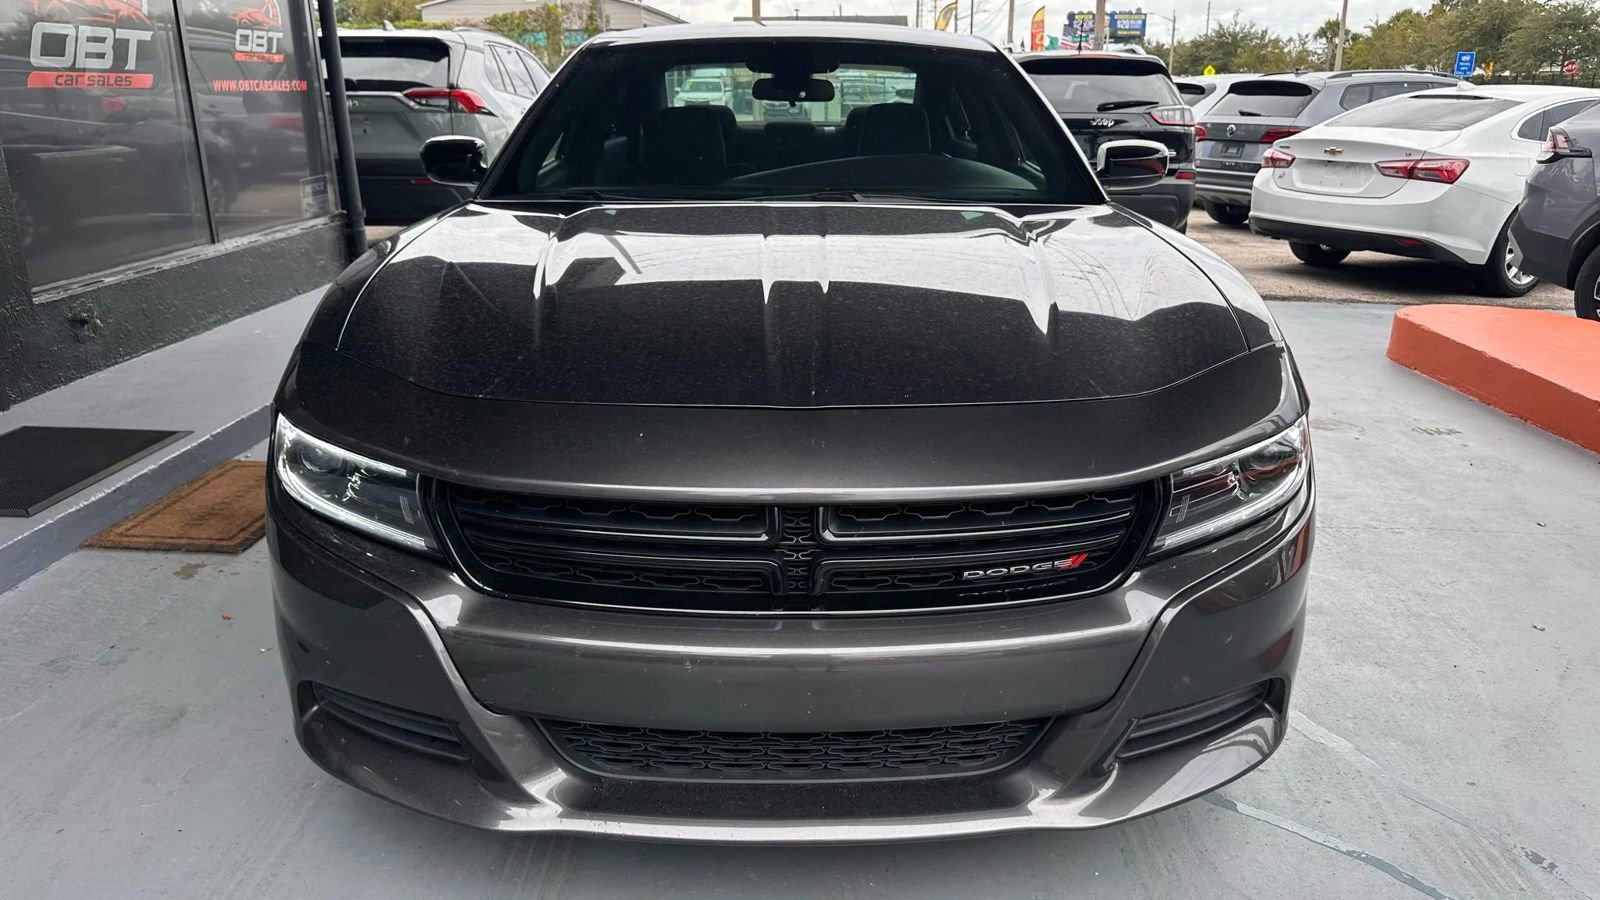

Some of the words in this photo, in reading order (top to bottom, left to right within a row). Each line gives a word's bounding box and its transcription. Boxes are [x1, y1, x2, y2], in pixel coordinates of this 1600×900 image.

[29, 22, 154, 71] OBT
[235, 28, 284, 53] OBT
[55, 74, 84, 87] car
[212, 79, 308, 92] WWW.OBTCARSALES.COM
[1089, 118, 1115, 128] Jeep
[963, 558, 1074, 580] DODGE
